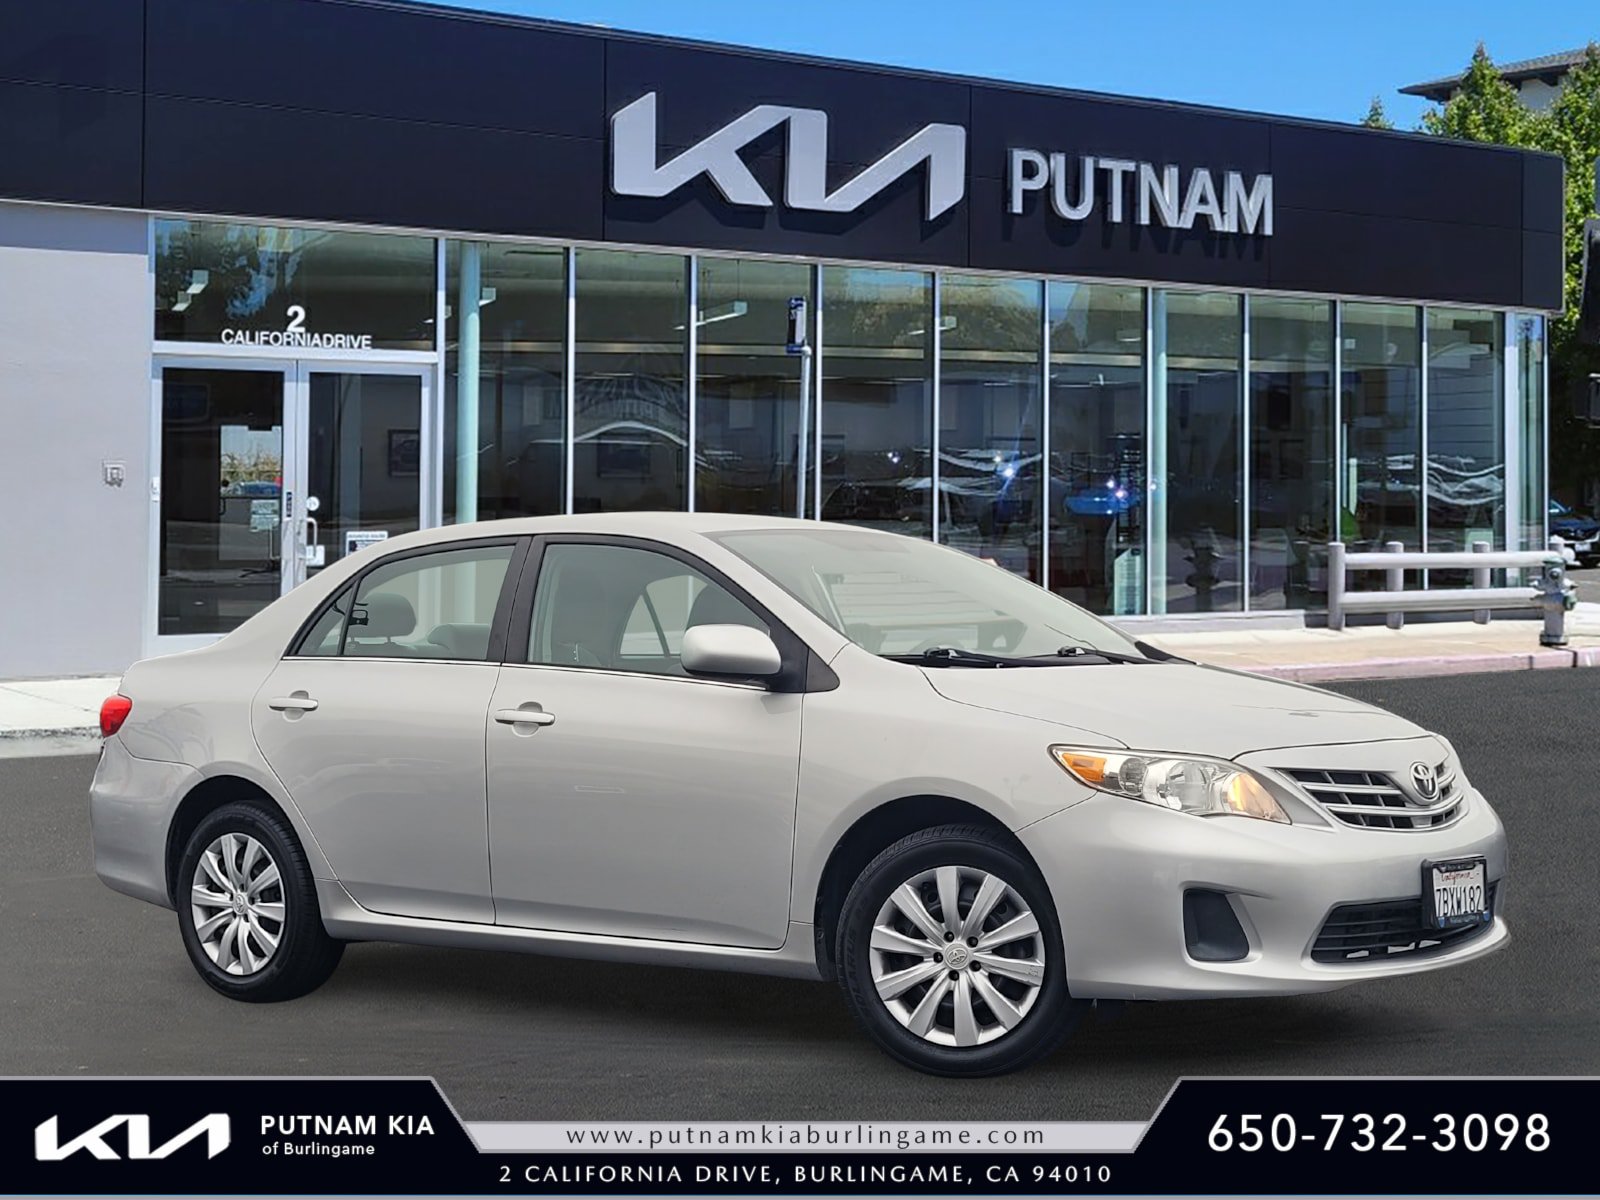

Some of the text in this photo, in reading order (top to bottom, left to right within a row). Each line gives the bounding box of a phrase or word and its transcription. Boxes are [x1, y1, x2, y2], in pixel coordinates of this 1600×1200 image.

[1008, 148, 1274, 236] PUTNAM
[286, 305, 306, 333] 2
[1436, 885, 1482, 917] 7BXW182
